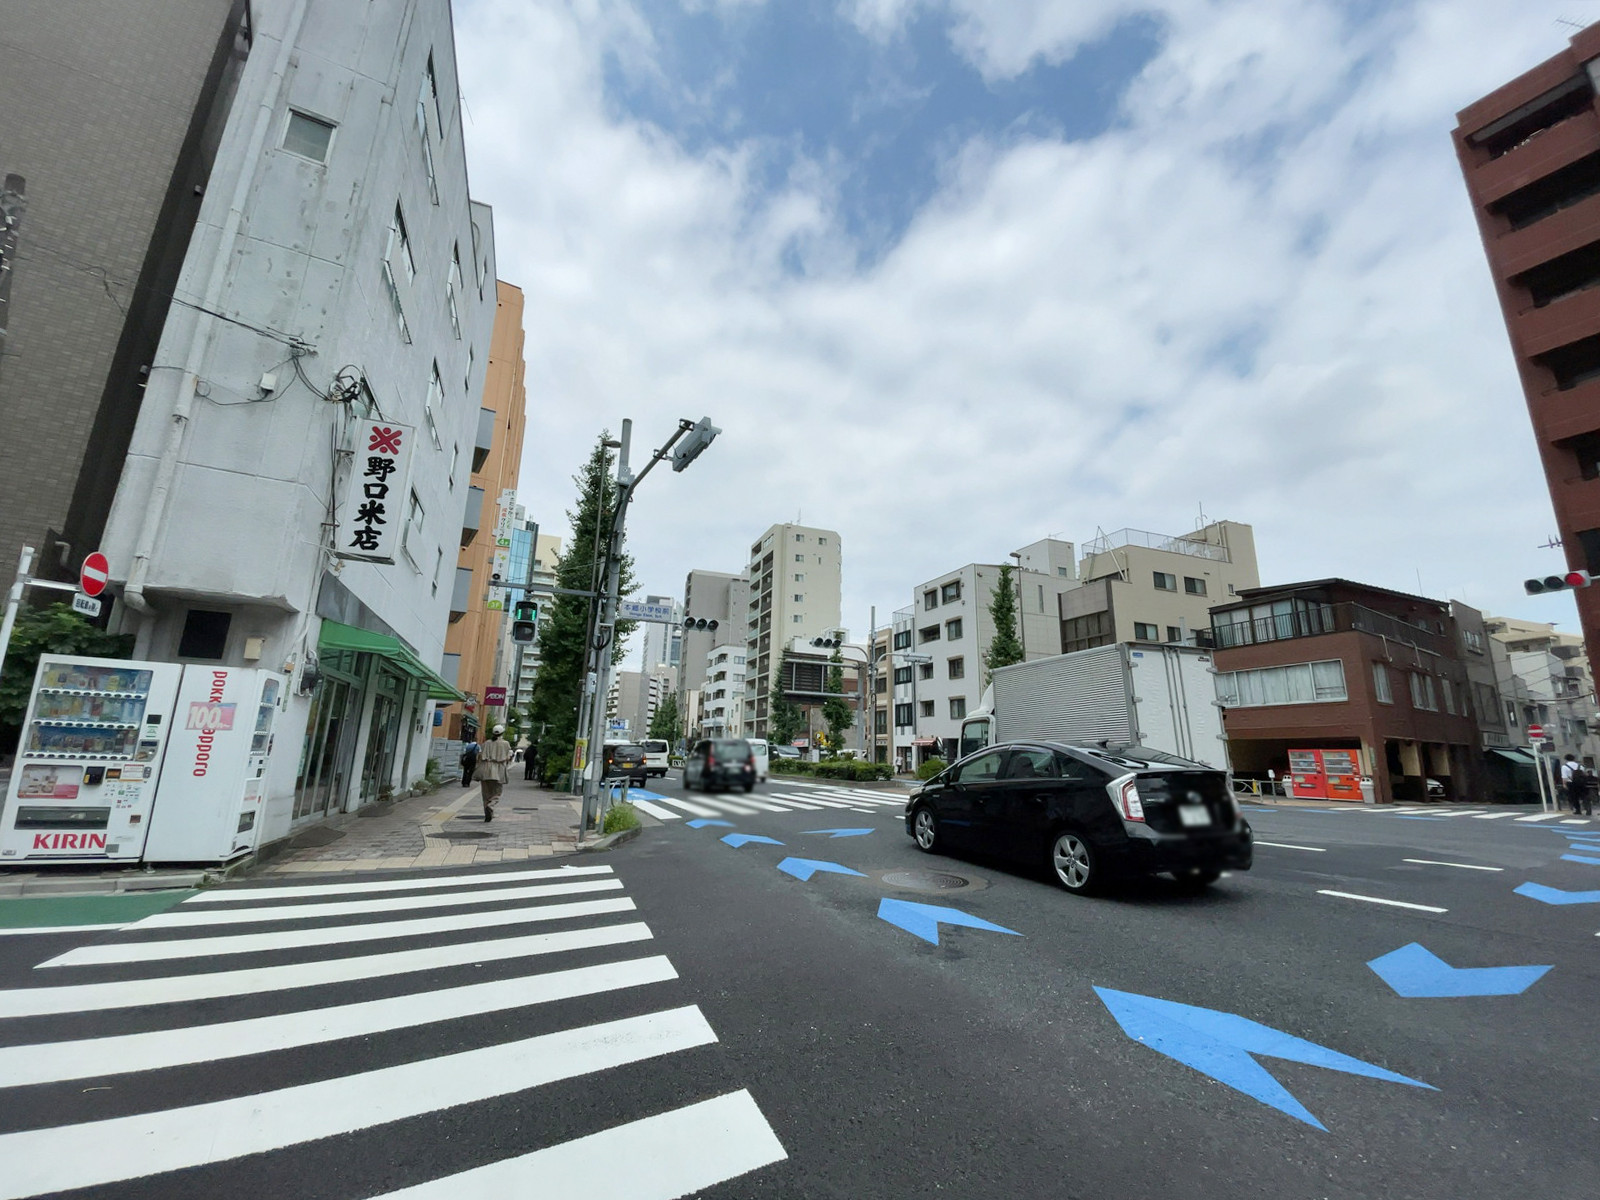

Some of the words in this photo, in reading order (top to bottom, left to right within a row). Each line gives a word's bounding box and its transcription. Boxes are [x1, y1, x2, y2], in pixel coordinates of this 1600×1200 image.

[349, 456, 396, 550] 野口米店
[193, 728, 216, 777] apporo
[33, 833, 107, 850] KIRIN
